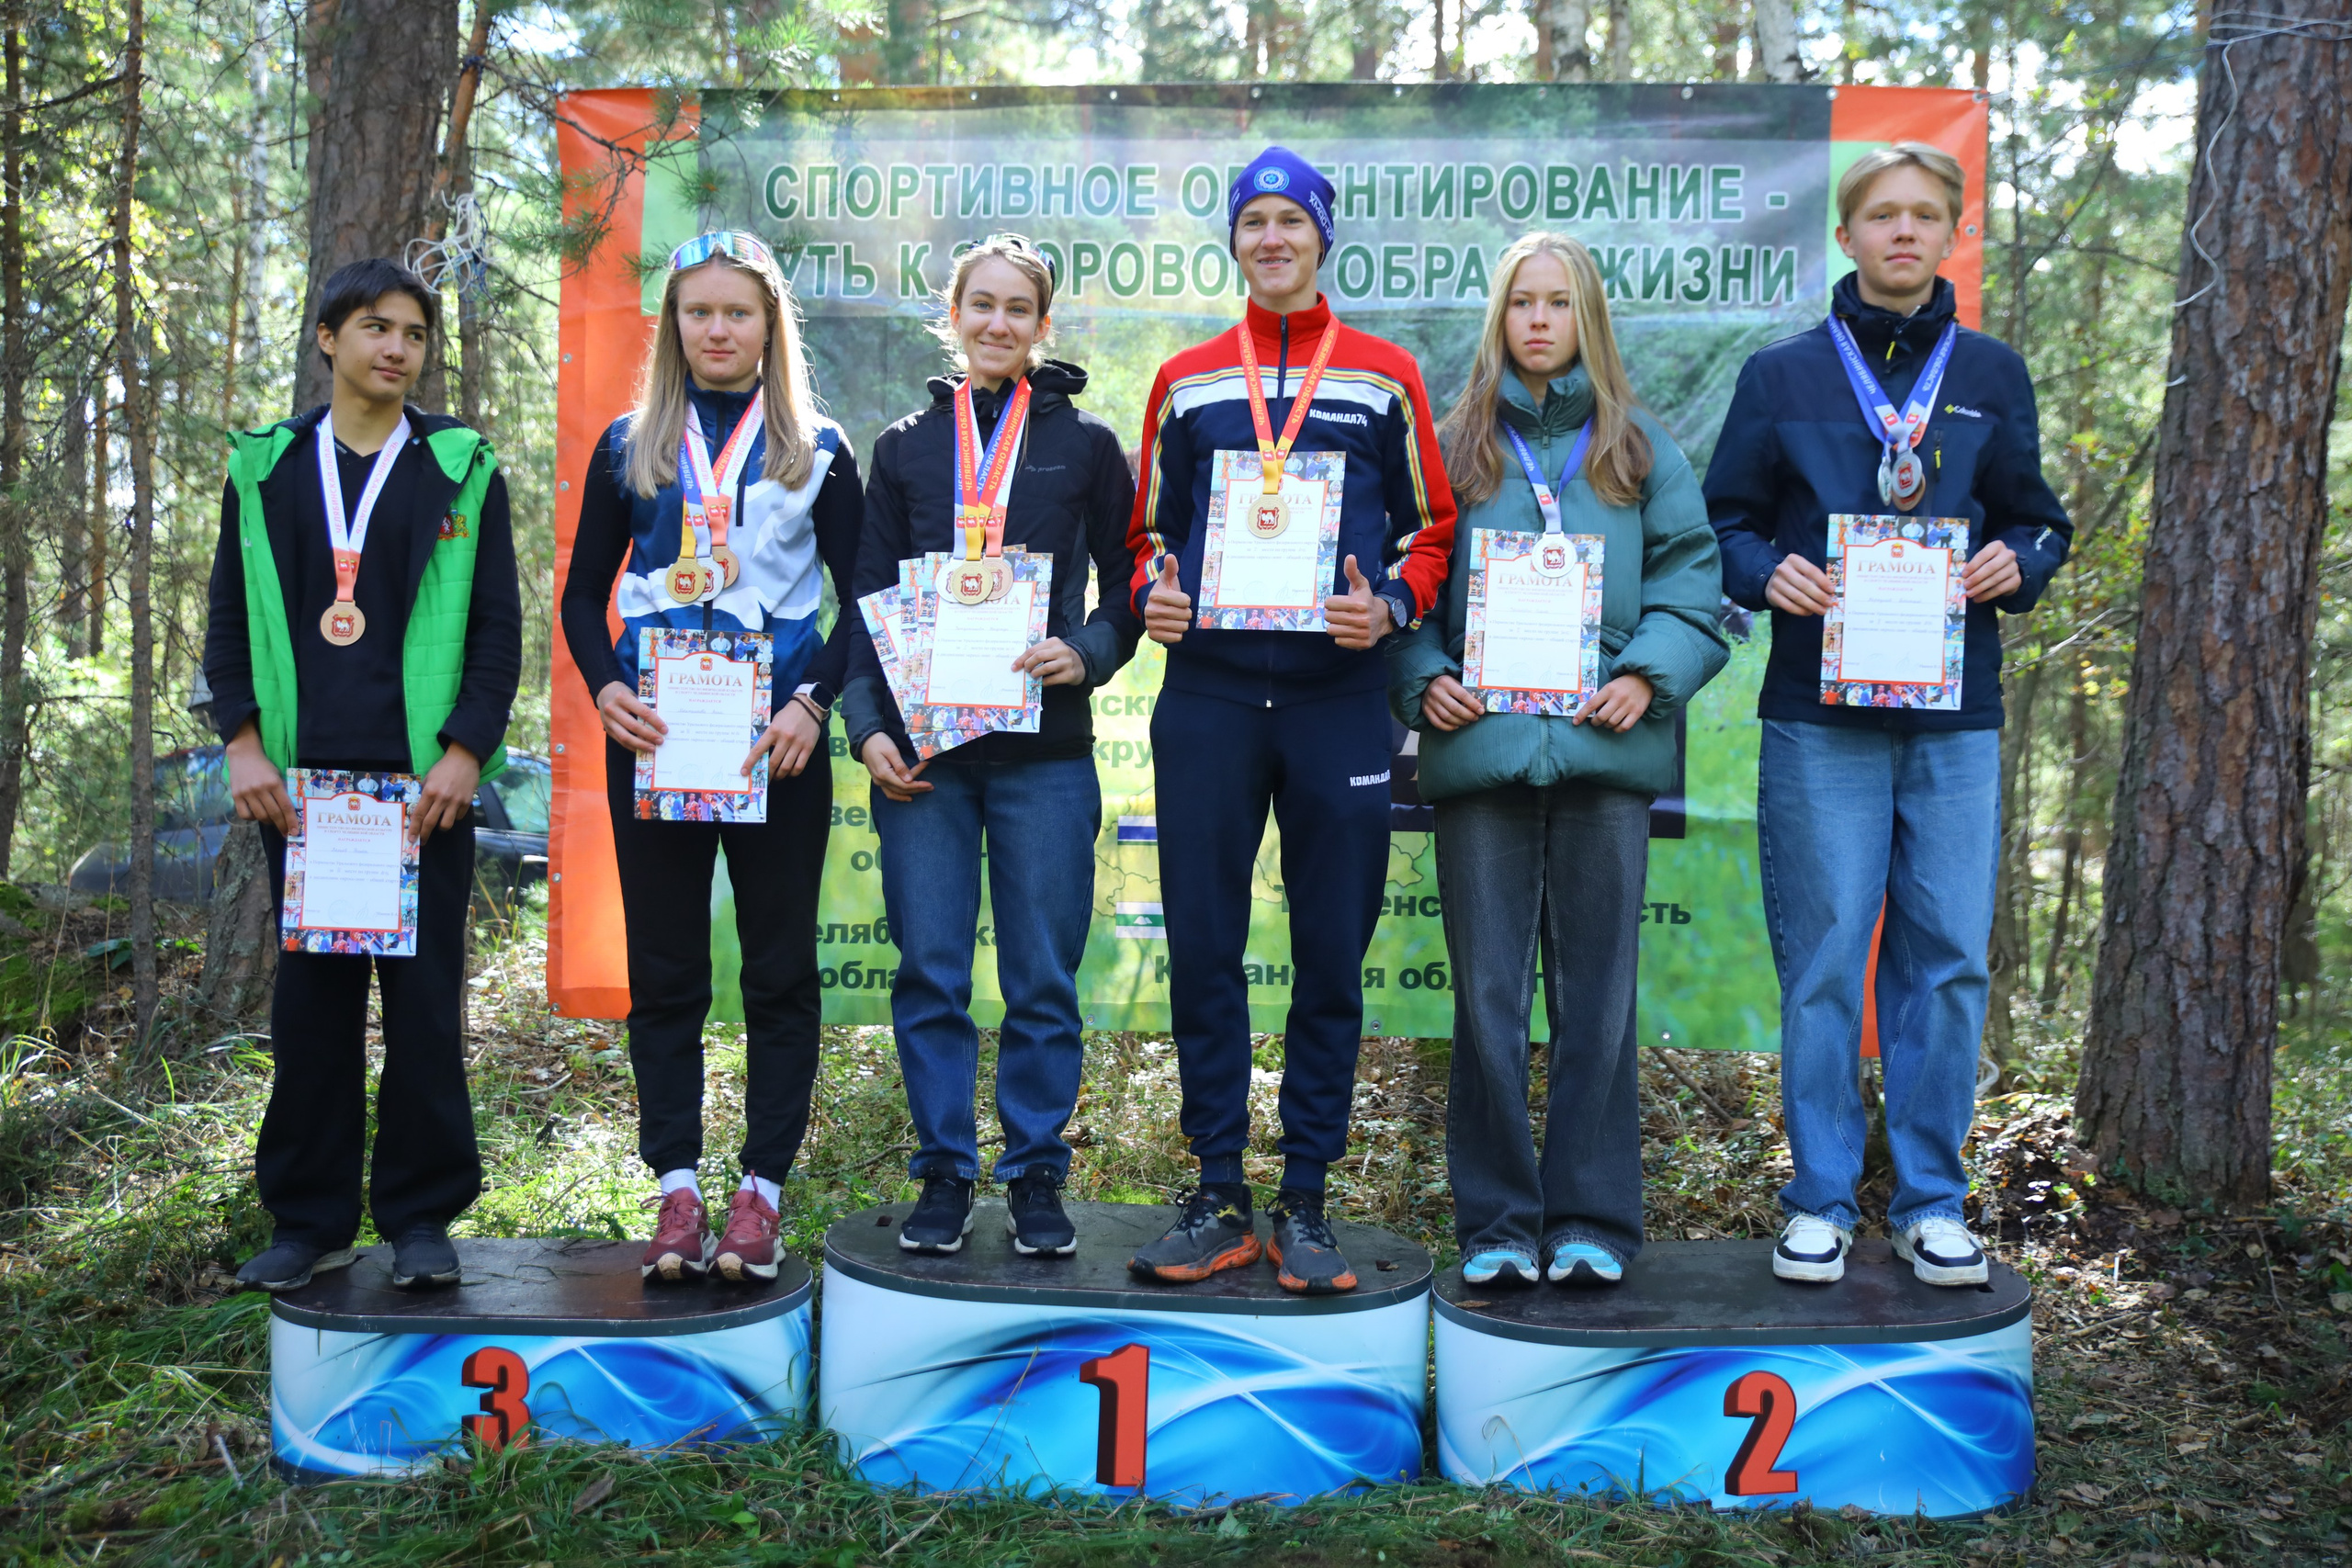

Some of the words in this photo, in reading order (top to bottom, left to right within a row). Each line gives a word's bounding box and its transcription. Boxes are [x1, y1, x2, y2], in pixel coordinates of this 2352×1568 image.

[765, 164, 1159, 220] СПОРТИВНОЕ
[1182, 164, 1743, 221] ОНТИРОВАНИЕ
[773, 244, 876, 297] УТЬ
[901, 244, 930, 297] К
[1589, 245, 1798, 301] ЖИЗНИ
[1241, 330, 1253, 365] ОБЛАСТЬ
[1308, 329, 1335, 386] ЧЕЛЯБИНСКАЯ
[959, 392, 967, 430] ОБЛАСТЬ
[1248, 366, 1265, 426] ЧЕЛЯБИНСКАЯ
[1291, 386, 1312, 424] ОБЛАСТЬ
[1309, 408, 1368, 427] КОМАНДА74
[1002, 394, 1027, 451] ЧЕЛЯБИНСКАЯ
[324, 434, 334, 471] ОБЛАСТЬ
[961, 431, 972, 491] ЧЕЛЯБИНСКАЯ
[989, 451, 1008, 491] ОБЛАСТЬ
[328, 472, 343, 534] ЧЕЛЯБИНСКАЯ
[356, 495, 373, 535] ОБЛАСТЬ
[1857, 559, 1936, 575] ГРАМОТА
[668, 671, 743, 687] ГРАМОТА
[317, 811, 391, 827] ГРАМОТА
[461, 1346, 531, 1456] 3
[1080, 1342, 1150, 1487] 1
[1724, 1370, 1798, 1496] 2
